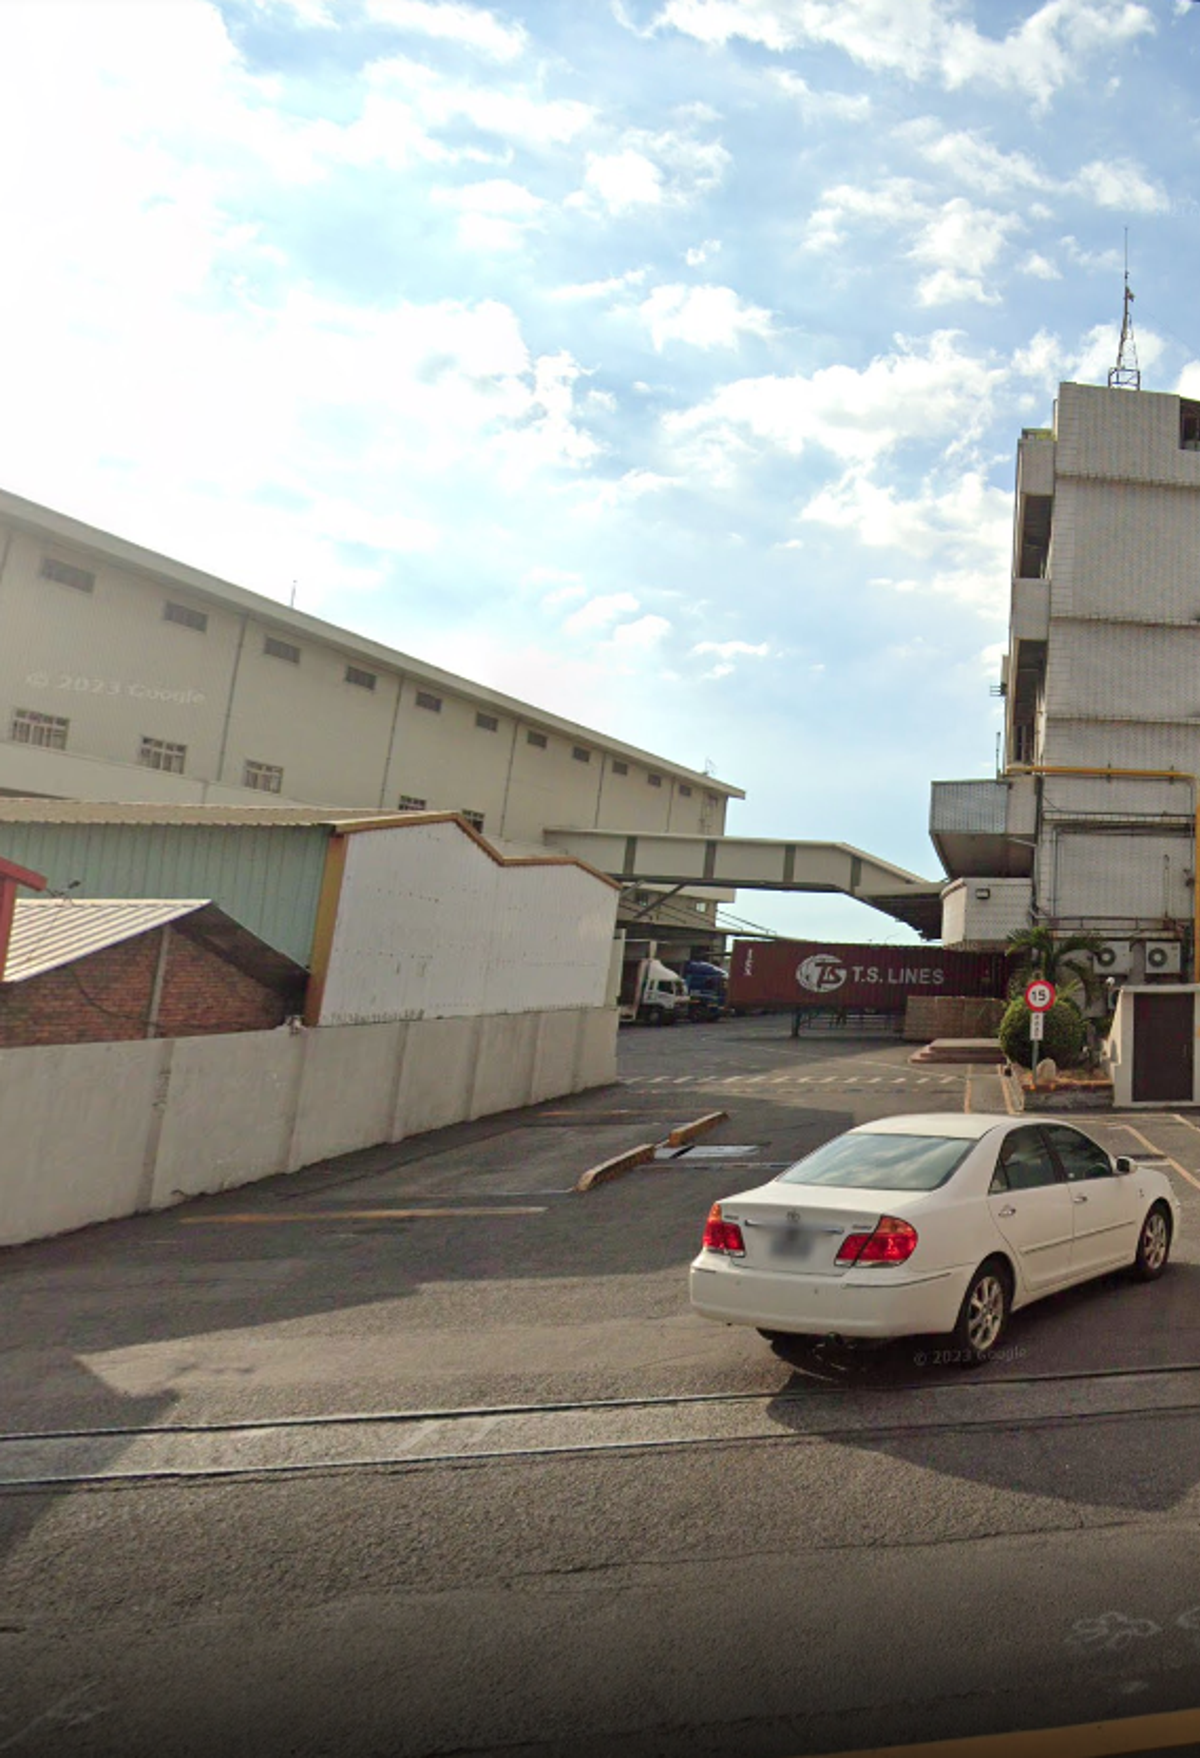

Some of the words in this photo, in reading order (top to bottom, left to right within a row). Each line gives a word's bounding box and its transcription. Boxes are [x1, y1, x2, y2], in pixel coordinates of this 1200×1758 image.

[852, 966, 883, 983] T.S.
[887, 967, 944, 985] LINES
[1031, 990, 1047, 1001] 15
